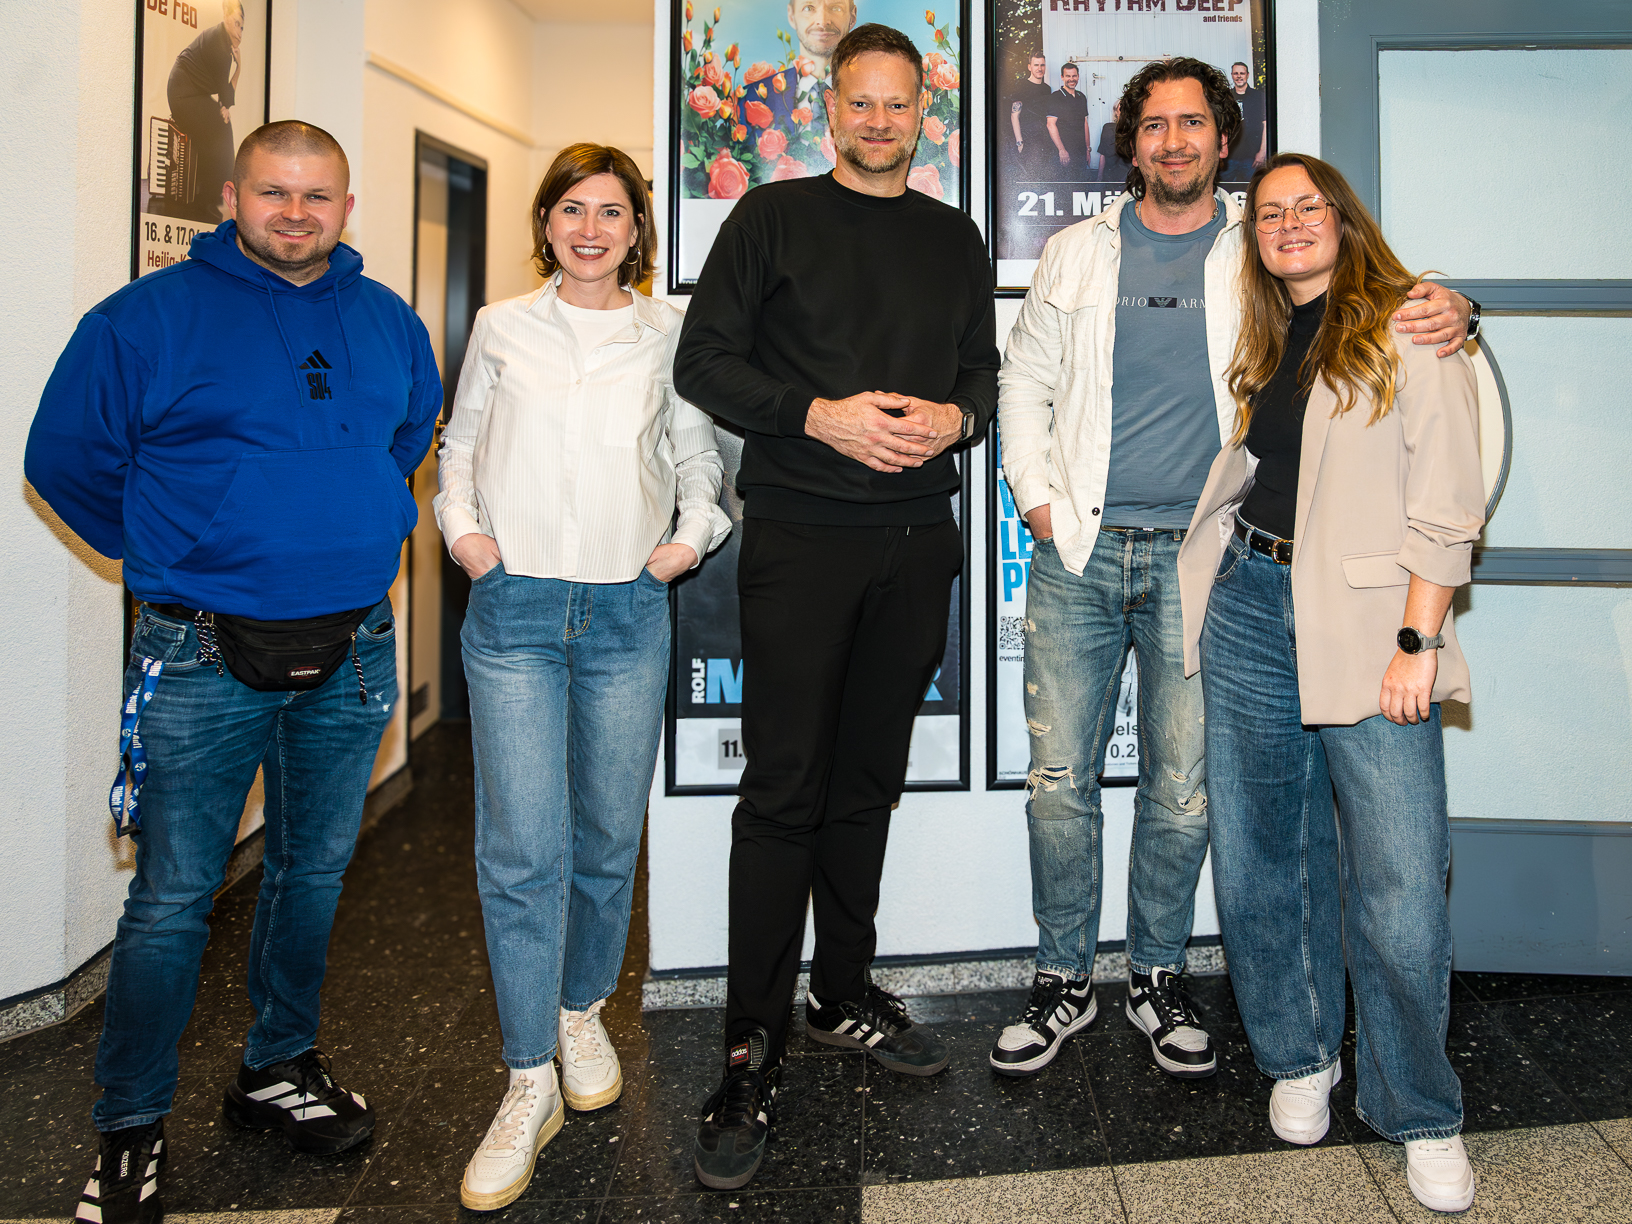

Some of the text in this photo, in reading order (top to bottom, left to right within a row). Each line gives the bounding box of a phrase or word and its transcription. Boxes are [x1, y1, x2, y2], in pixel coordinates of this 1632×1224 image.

[1018, 191, 1064, 216] 21.
[145, 222, 200, 246] 16. & 17.0
[1117, 296, 1147, 307] RIO
[291, 669, 321, 677] EASTPAK
[691, 658, 705, 704] ROLF
[721, 740, 742, 758] 11.
[1110, 743, 1138, 758] 0.2
